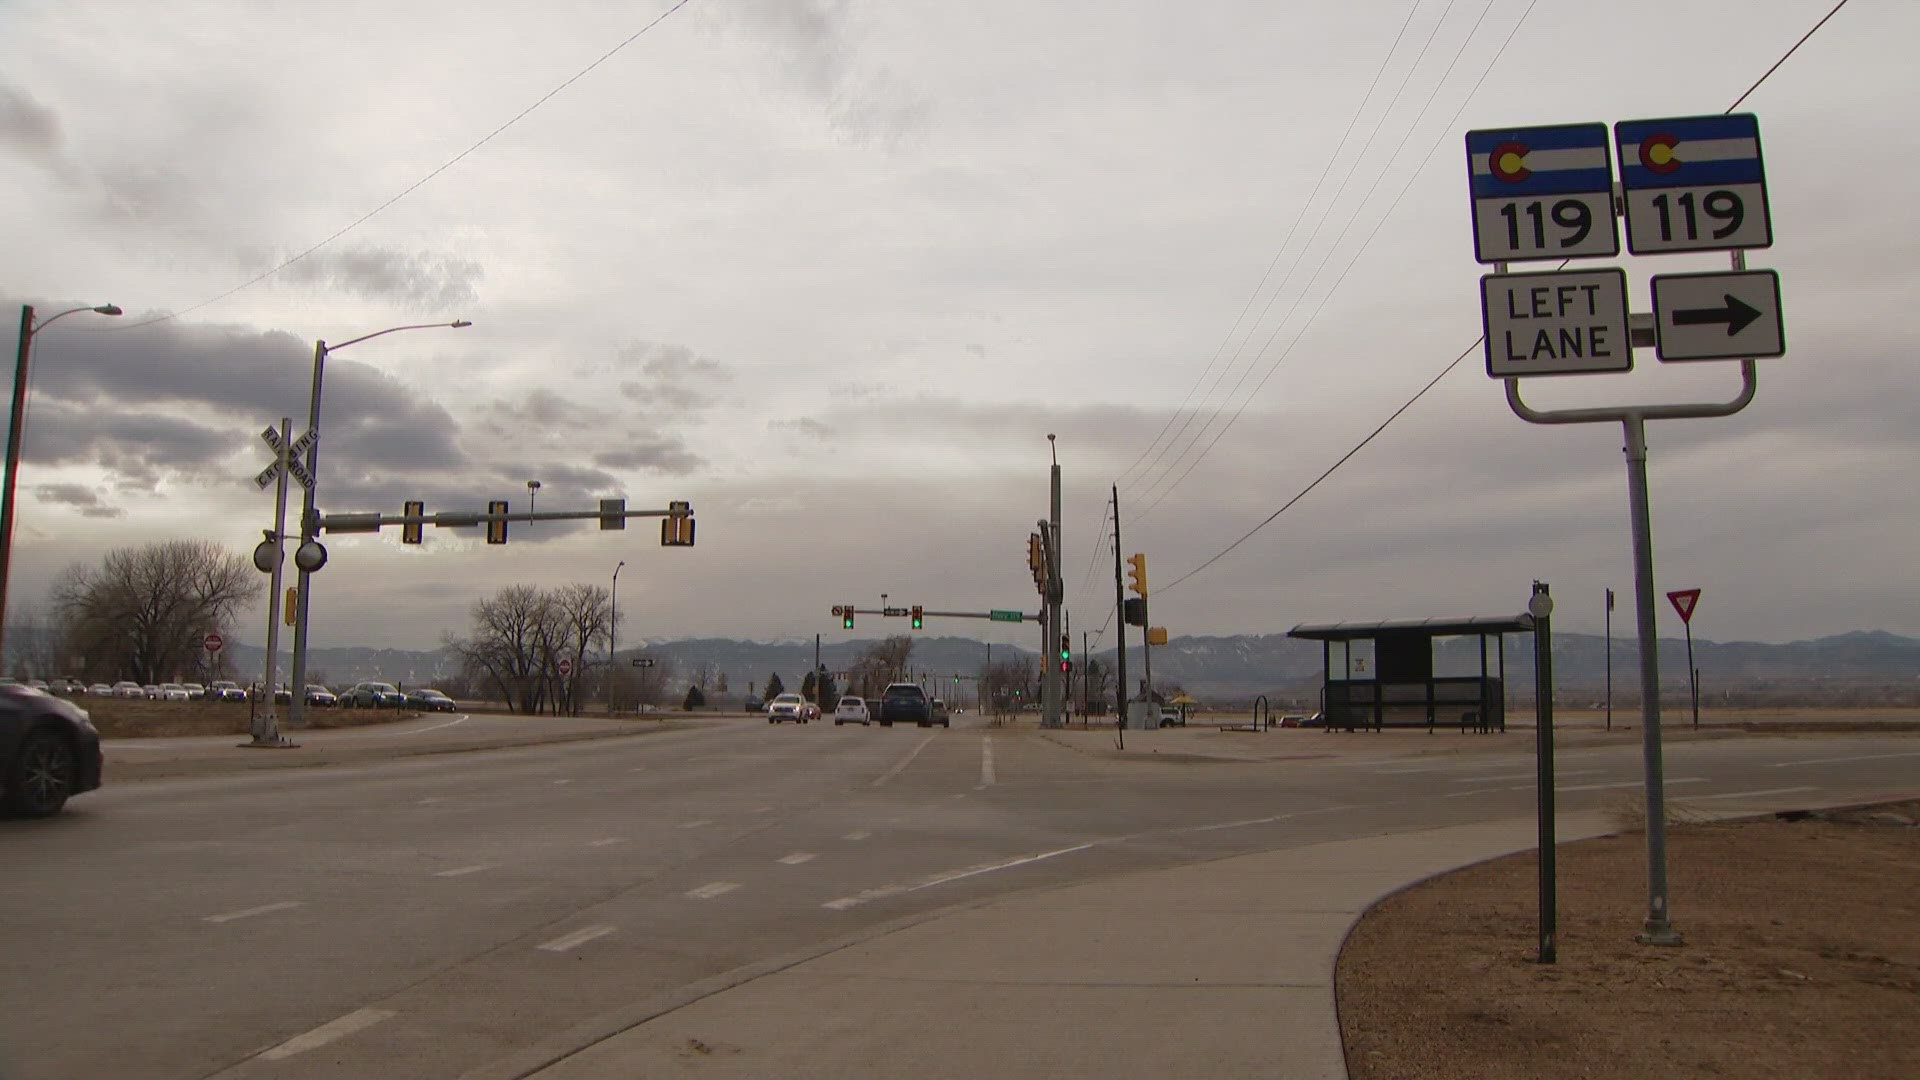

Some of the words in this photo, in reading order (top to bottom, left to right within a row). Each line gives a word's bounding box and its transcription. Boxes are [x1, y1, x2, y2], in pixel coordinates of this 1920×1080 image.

[1501, 199, 1592, 250] 119
[1652, 190, 1744, 241] 119
[1508, 285, 1600, 319] LEFT
[1506, 326, 1610, 361] LANE
[264, 430, 281, 454] RAI
